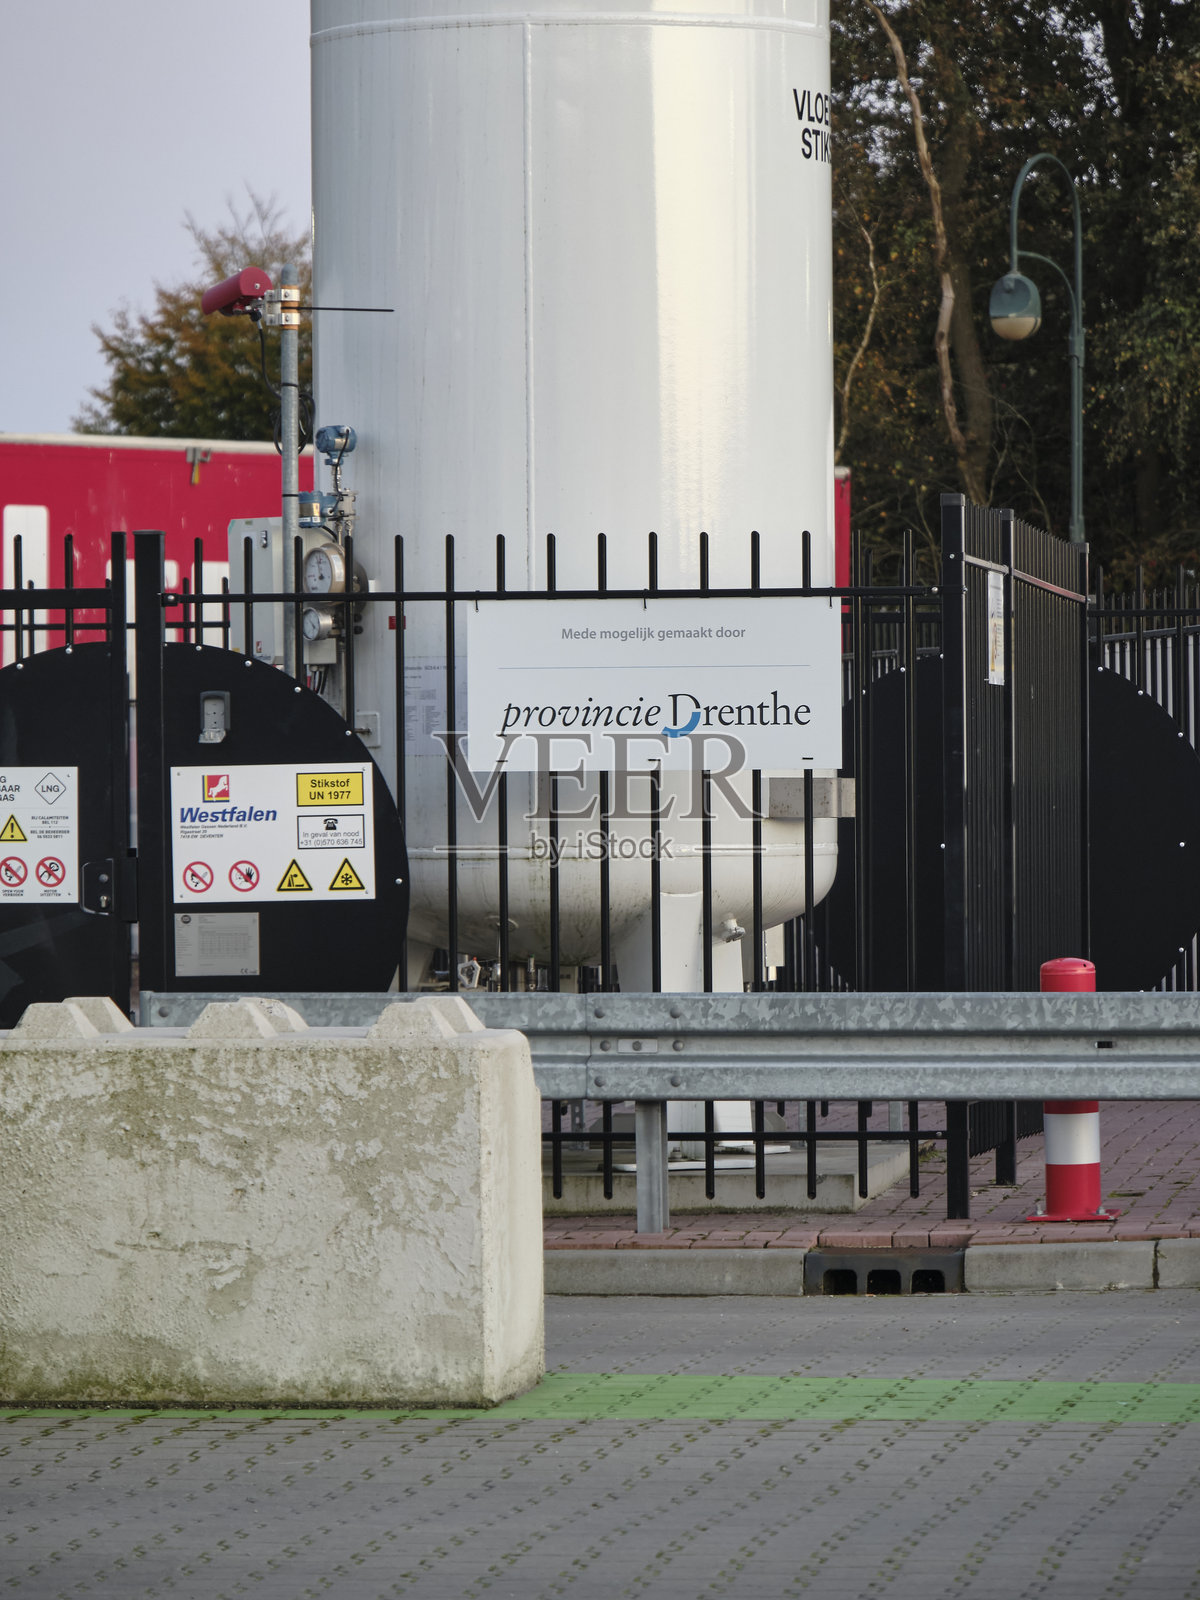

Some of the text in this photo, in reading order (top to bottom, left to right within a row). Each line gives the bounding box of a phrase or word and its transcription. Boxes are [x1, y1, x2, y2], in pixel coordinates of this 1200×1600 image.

[801, 127, 832, 164] STIK
[561, 626, 746, 642] Mede mogelijk gemaakt door
[498, 696, 661, 737] provincie
[661, 689, 812, 739] Drenthe
[0, 784, 20, 792] AAR
[41, 784, 60, 792] LNG
[310, 778, 350, 788] Stikstof
[309, 790, 351, 800] UN 1977
[180, 806, 278, 823] Westfalen
[310, 831, 328, 839] geval
[313, 839, 335, 847] (0)570
